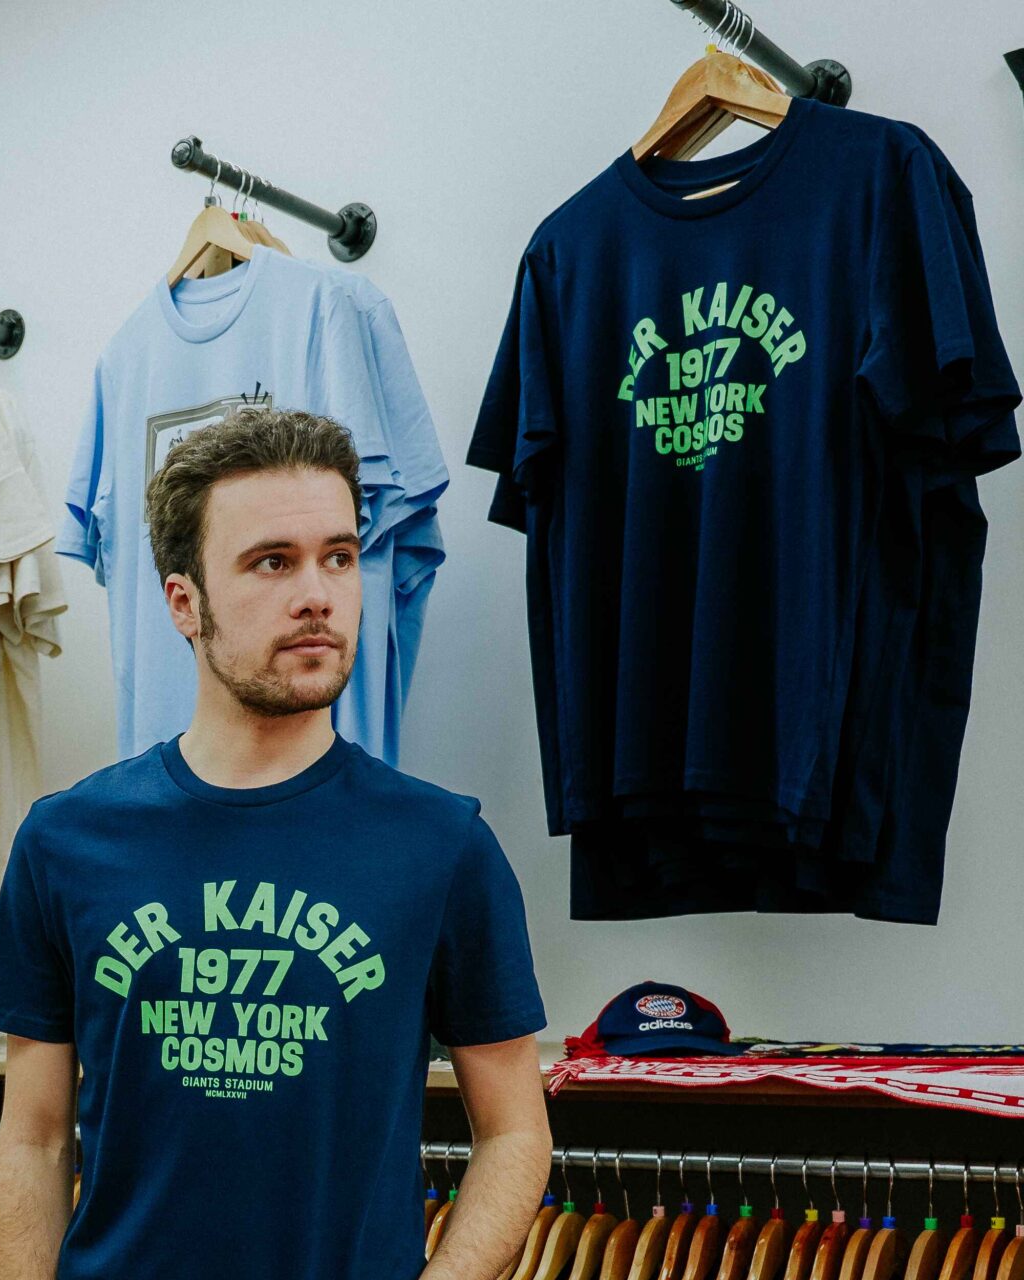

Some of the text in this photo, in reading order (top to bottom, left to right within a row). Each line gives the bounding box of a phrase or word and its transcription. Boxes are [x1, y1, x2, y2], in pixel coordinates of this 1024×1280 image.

[681, 281, 807, 378] KAISER
[635, 393, 698, 428] NEW
[94, 879, 386, 1003] DER KAISER
[178, 947, 294, 996] 1977
[140, 1000, 330, 1041] NEW YORK
[638, 1019, 693, 1031] adidas
[161, 1036, 304, 1077] COSMOS
[182, 1076, 274, 1092] GIANTS STADIUM
[205, 1089, 247, 1100] MCMLXXVII
